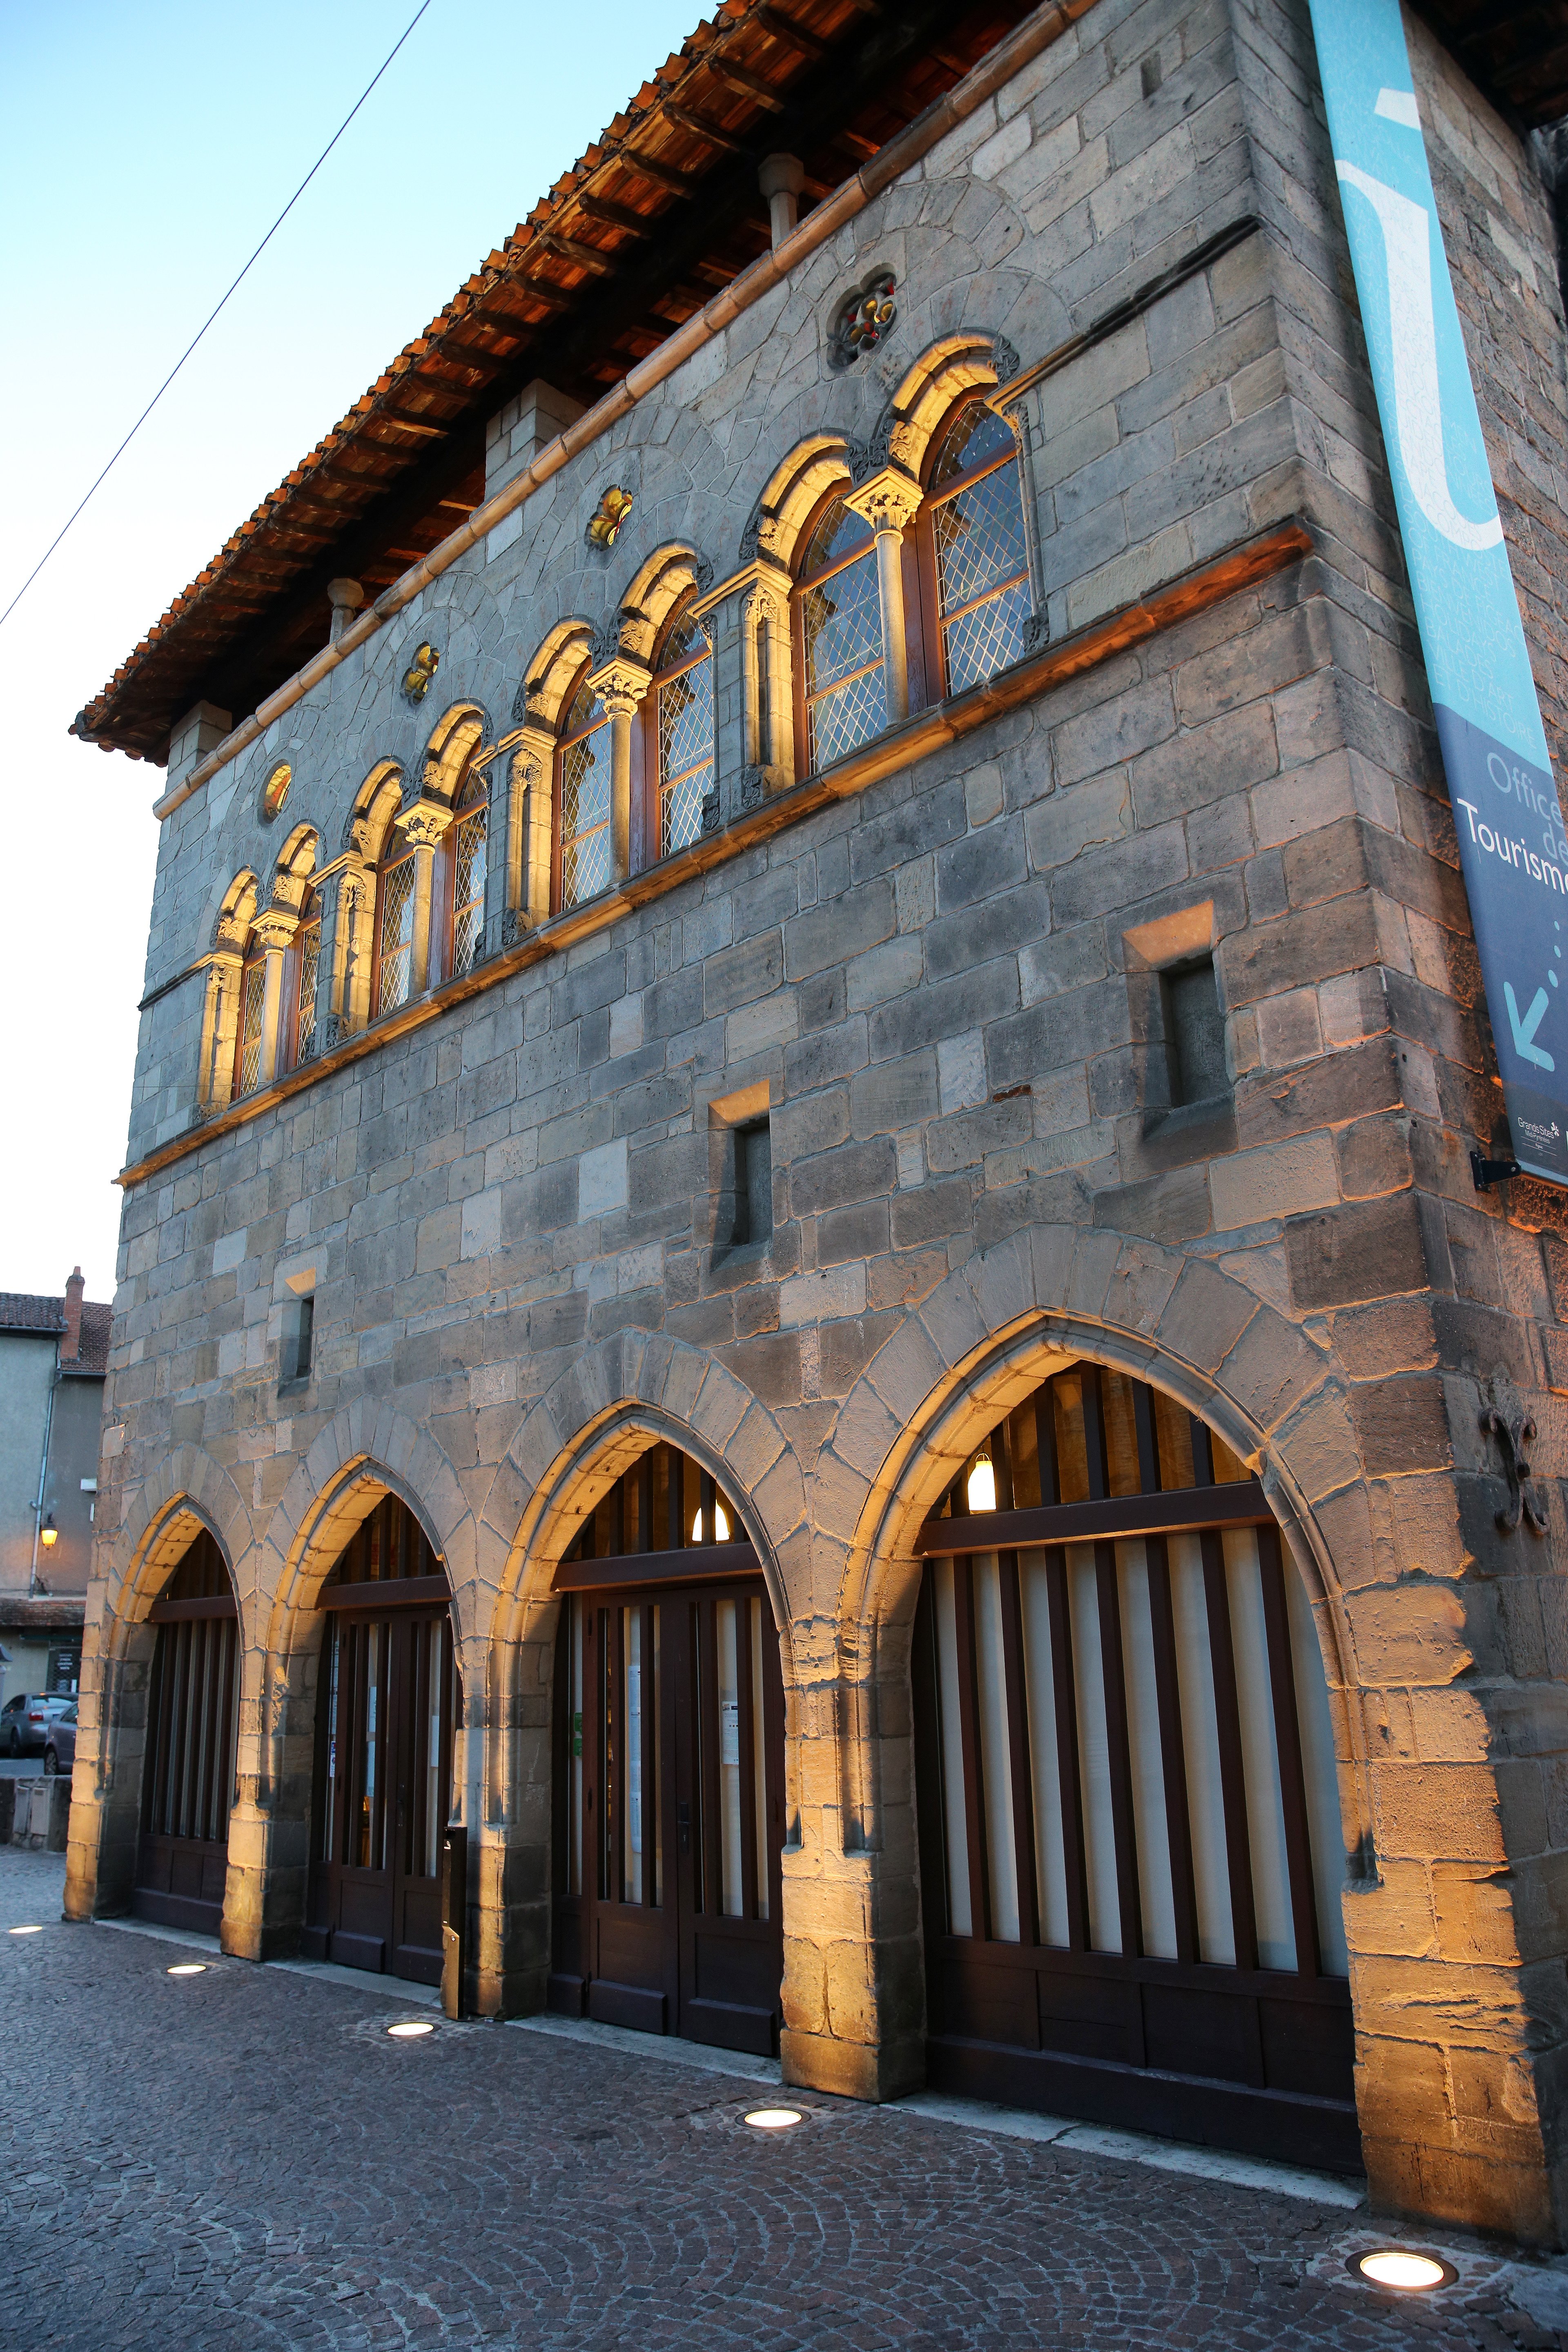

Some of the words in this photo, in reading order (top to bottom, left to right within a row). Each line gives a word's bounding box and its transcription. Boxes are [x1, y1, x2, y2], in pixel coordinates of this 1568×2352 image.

[1372, 333, 1444, 410] BONJOUR
[1396, 336, 1427, 376] PUY
[1374, 354, 1478, 454] WILLKOMMEN
[1379, 373, 1467, 463] SPECTACLES
[1382, 394, 1444, 460] GUIDED
[1443, 445, 1494, 501] TOURS
[1402, 501, 1459, 561] SOUTH
[1463, 549, 1499, 590] WEST
[1413, 473, 1483, 545] JACQUES
[1406, 522, 1432, 557] OF
[1433, 544, 1493, 605] FRANCE
[1410, 545, 1449, 590] PAYS
[1450, 575, 1472, 607] DE
[1474, 595, 1526, 647] FIGEAC
[1415, 568, 1516, 659] BIENVENIDOS
[1419, 590, 1497, 665] HOLIDAYS
[1423, 614, 1494, 682] BALADES
[1426, 635, 1469, 683] VILLE
[1432, 660, 1451, 690] ET
[1487, 752, 1564, 828] Office
[1543, 823, 1568, 866] de
